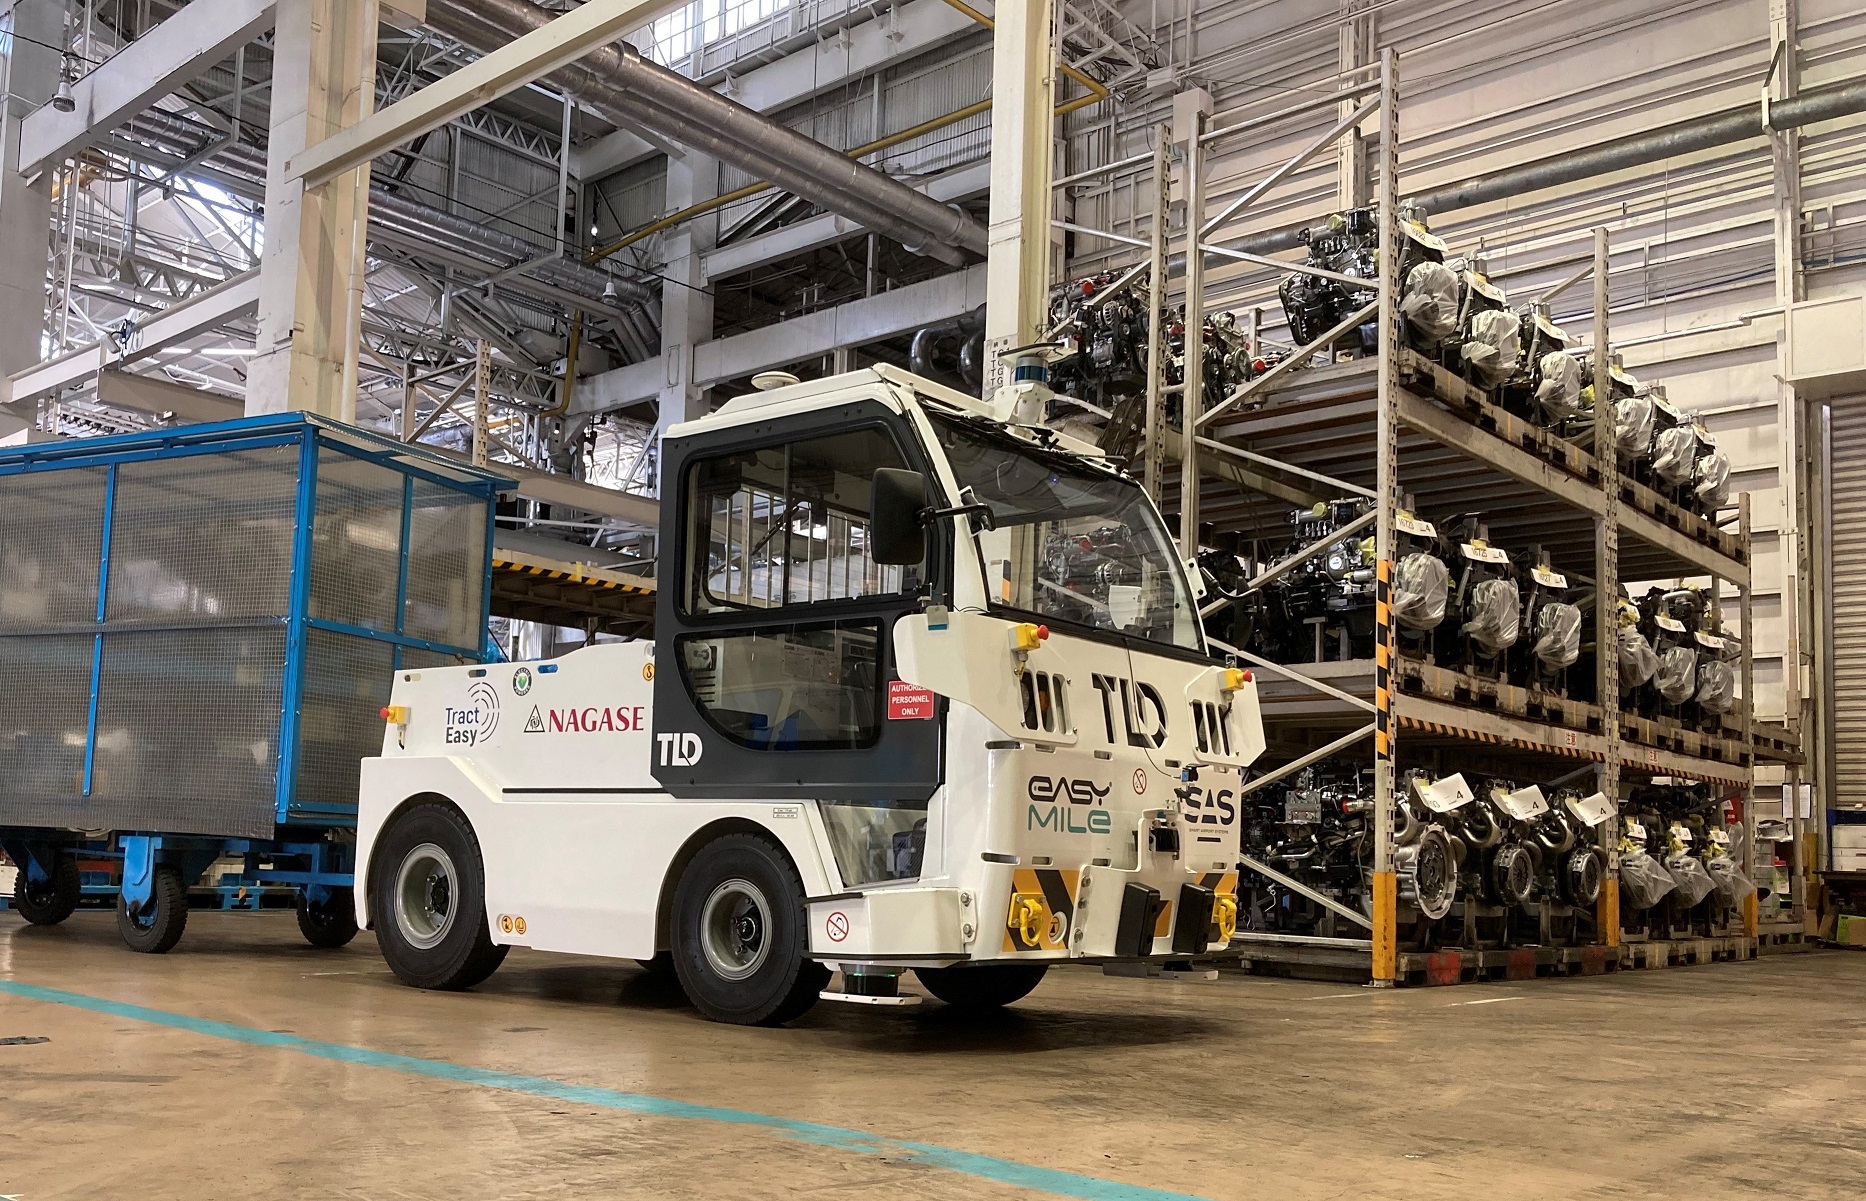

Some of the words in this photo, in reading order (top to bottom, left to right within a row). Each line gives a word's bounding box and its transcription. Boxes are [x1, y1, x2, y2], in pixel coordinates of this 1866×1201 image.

[891, 695, 930, 704] PERSONNEL
[445, 707, 480, 725] Tract
[901, 707, 920, 716] ONLY
[1090, 671, 1169, 749] TLD
[548, 706, 645, 733] NAGASE
[445, 727, 478, 748] Easy
[656, 732, 703, 767] TLD
[1456, 790, 1464, 799] 4
[1532, 801, 1539, 809] 4
[1600, 807, 1607, 815] 4
